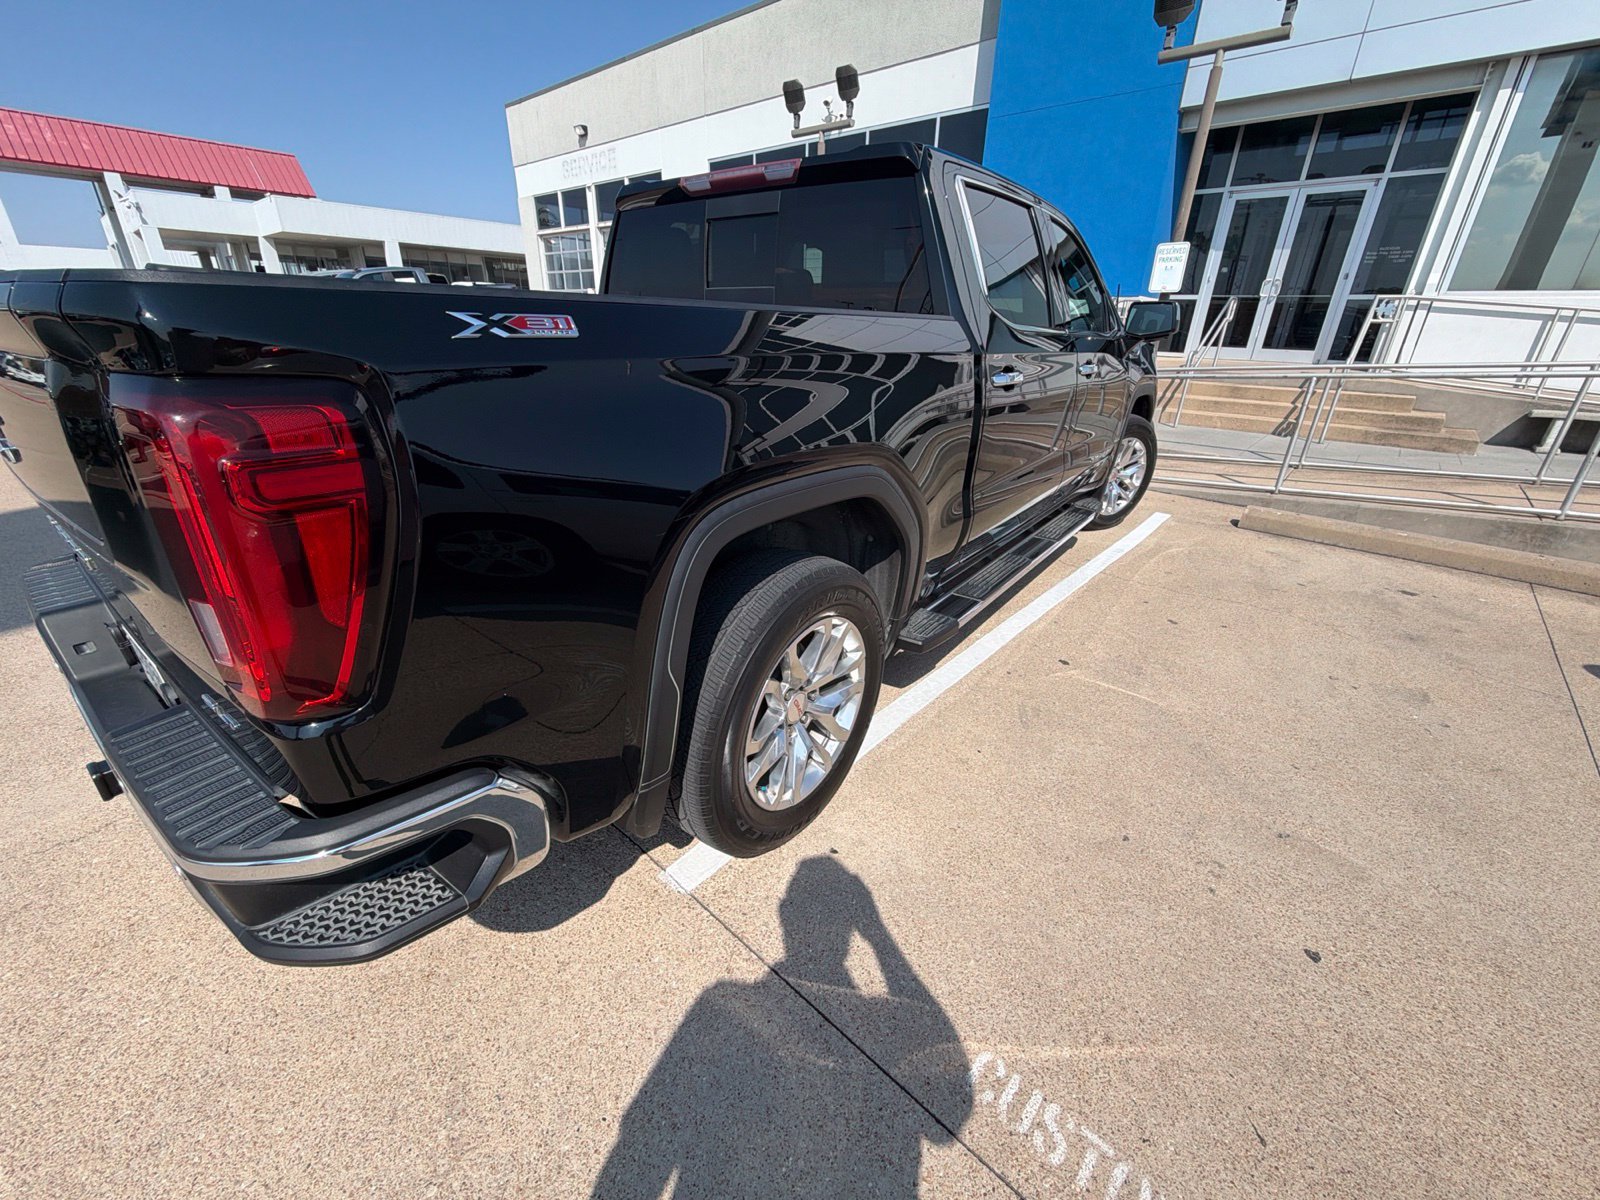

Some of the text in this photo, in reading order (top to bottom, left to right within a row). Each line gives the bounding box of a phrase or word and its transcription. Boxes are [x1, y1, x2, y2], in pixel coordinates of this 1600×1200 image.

[561, 148, 617, 179] SERVICE
[1158, 246, 1187, 256] RESERVED
[1158, 255, 1184, 264] PARKING
